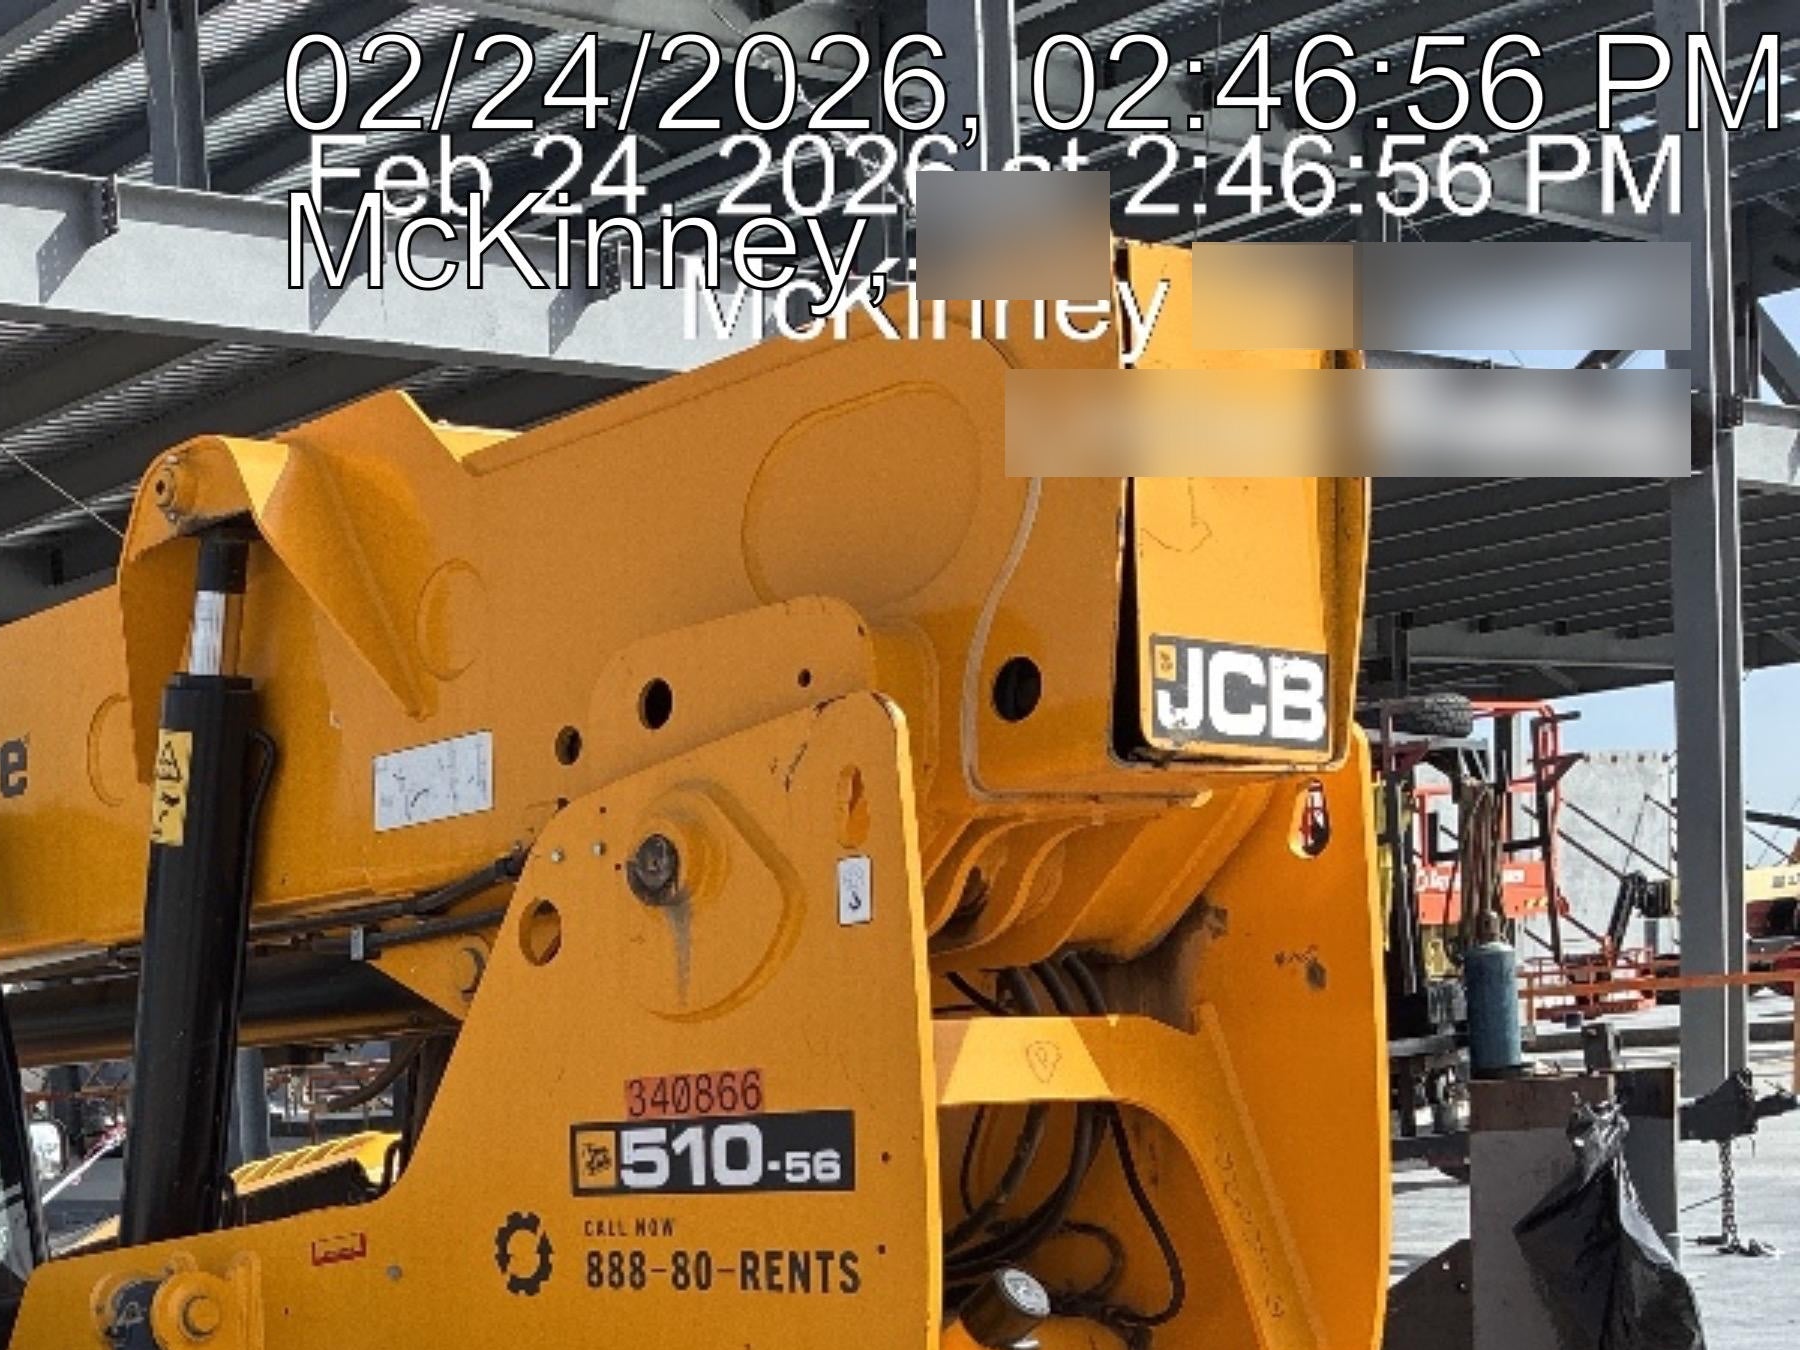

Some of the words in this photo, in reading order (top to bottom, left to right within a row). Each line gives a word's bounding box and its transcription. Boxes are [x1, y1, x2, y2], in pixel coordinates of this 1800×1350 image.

[1156, 647, 1327, 742] JCB
[627, 1069, 763, 1118] 340866
[620, 1122, 841, 1188] 510-56
[584, 1219, 628, 1238] CALL
[635, 1217, 676, 1237] NOW
[586, 1250, 862, 1294] 888-80-RENTS
